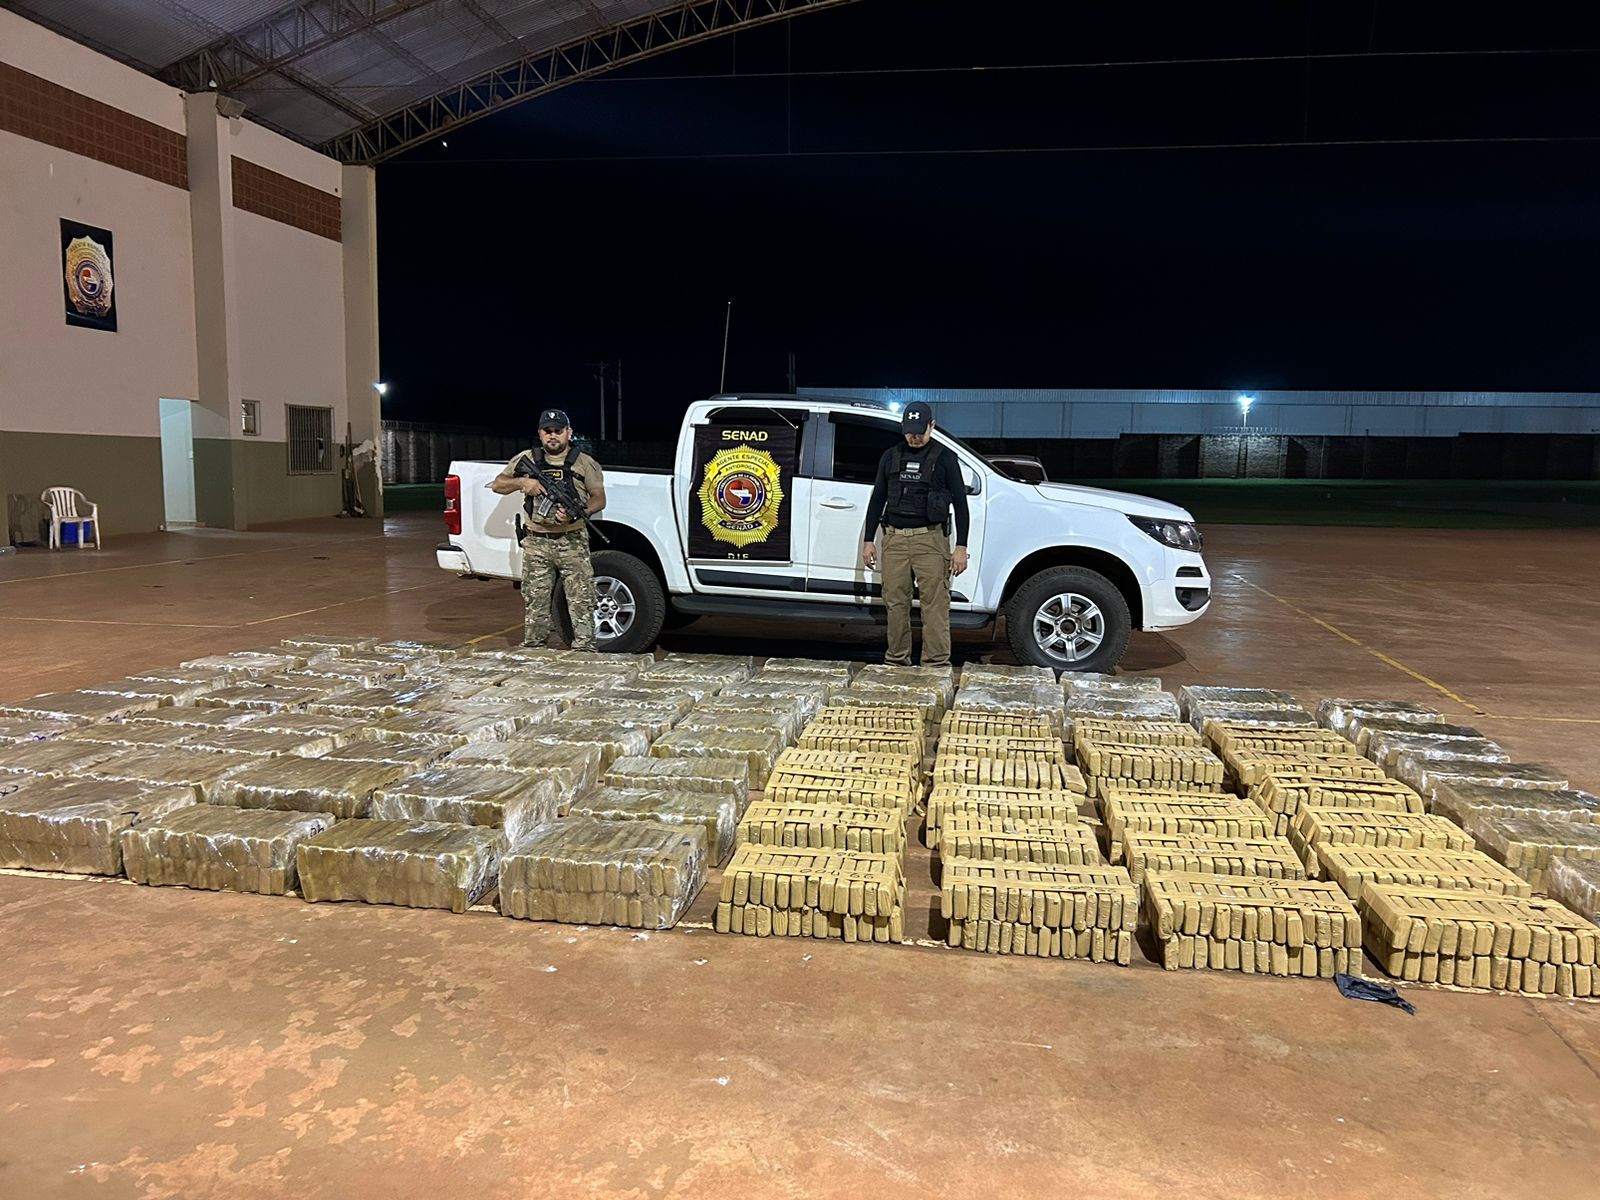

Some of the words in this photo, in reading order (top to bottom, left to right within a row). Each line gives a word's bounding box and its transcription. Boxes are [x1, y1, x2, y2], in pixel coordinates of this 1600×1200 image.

[721, 430, 769, 442] SENAD
[716, 454, 740, 467] AGENTE
[741, 453, 770, 468] ESPECIAL
[725, 521, 754, 531] SENAD
